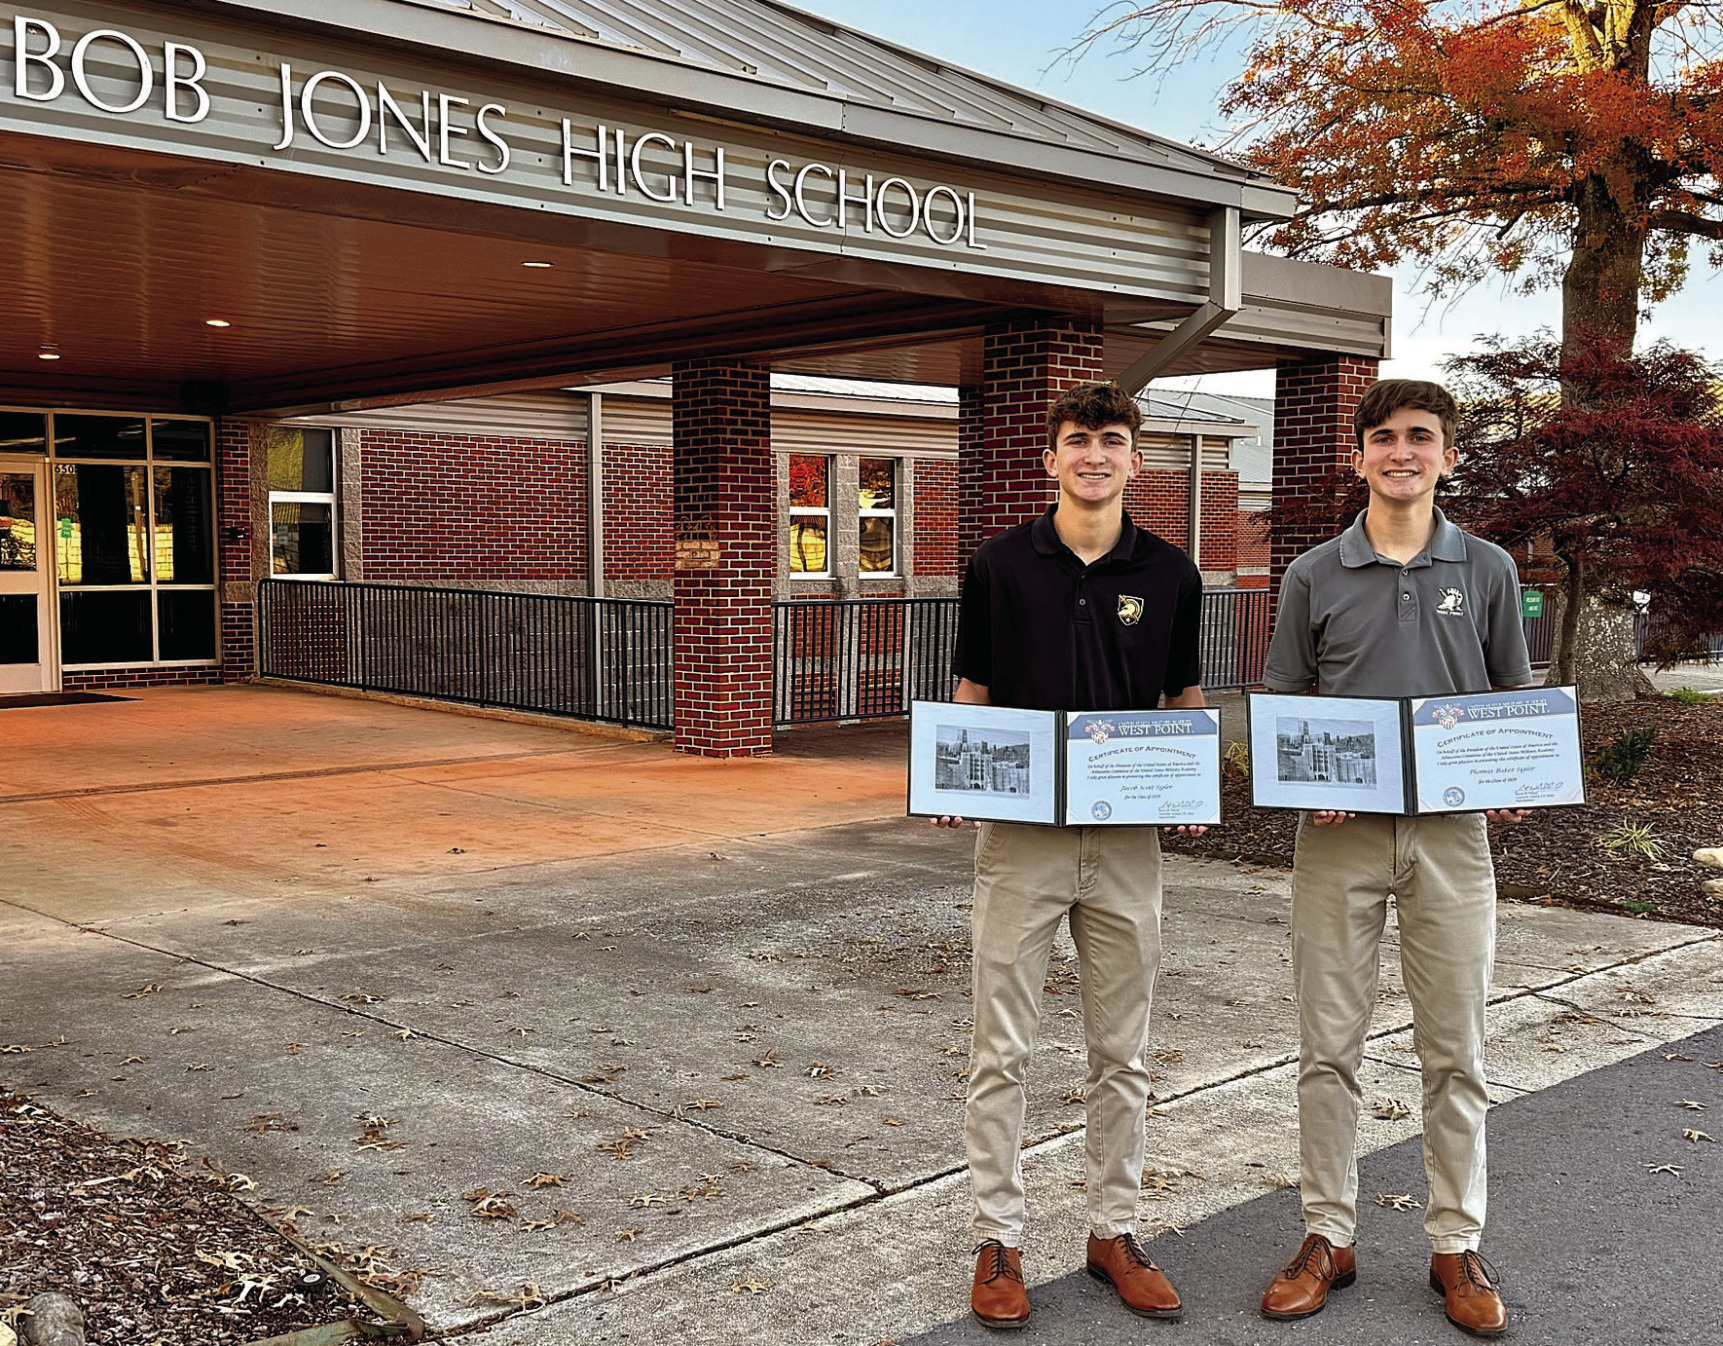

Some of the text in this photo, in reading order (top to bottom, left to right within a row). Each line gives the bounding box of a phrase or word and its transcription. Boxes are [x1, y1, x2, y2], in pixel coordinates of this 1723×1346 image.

[14, 15, 988, 250] BOB JONES HIGH SCHOOL
[1467, 707, 1501, 720] WEST
[1118, 724, 1151, 736] WEST
